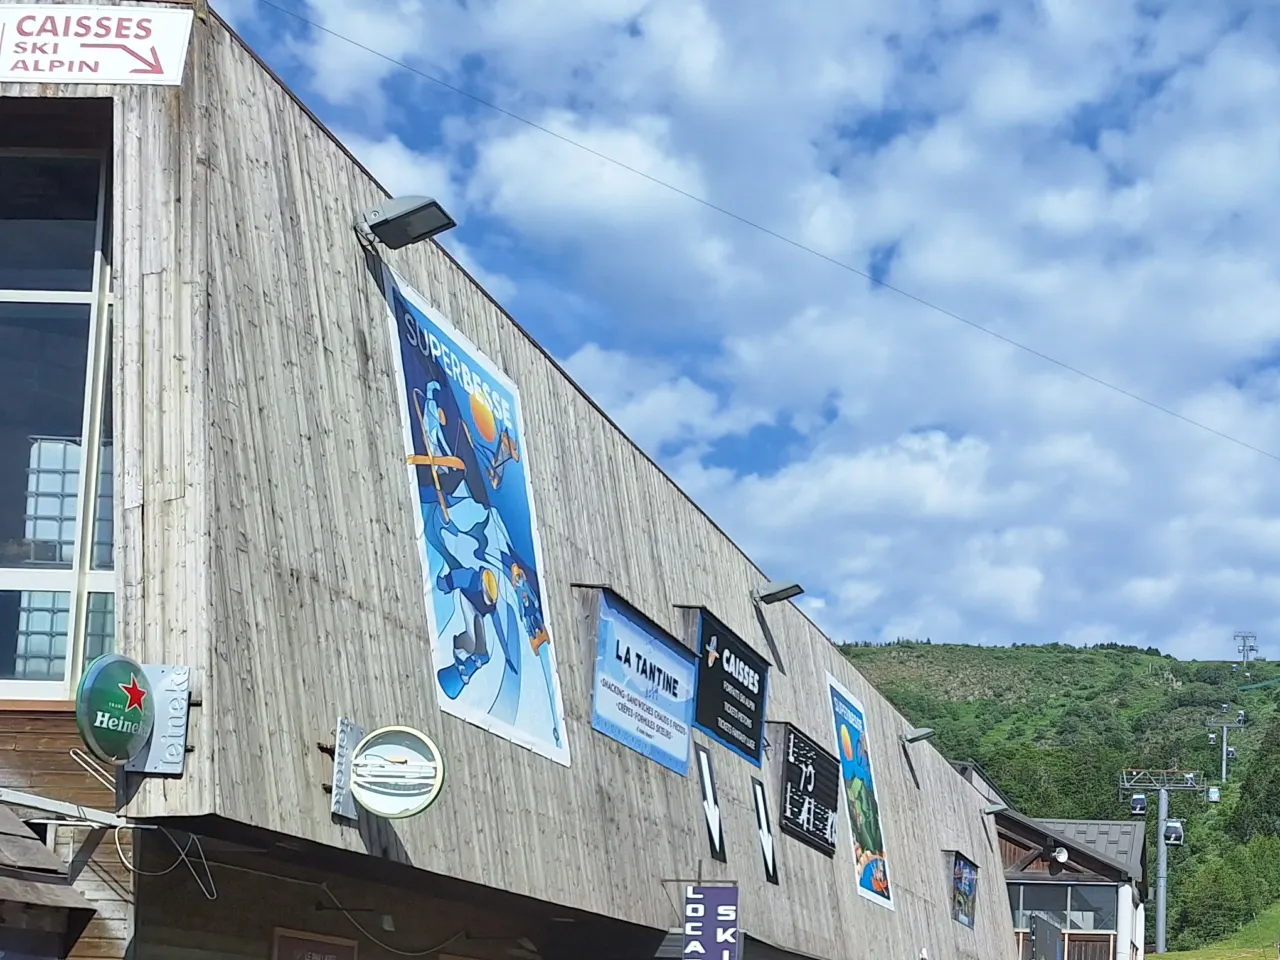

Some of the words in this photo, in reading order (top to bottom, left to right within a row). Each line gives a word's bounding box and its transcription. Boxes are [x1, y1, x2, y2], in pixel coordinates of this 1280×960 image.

[16, 15, 152, 40] CAISSES
[13, 41, 59, 55] SKI
[10, 60, 100, 73] ALPIN
[405, 313, 512, 429] SUPERBESSE
[616, 639, 632, 670] LA
[636, 652, 679, 698] TANTINE
[722, 648, 760, 694] CAISSES
